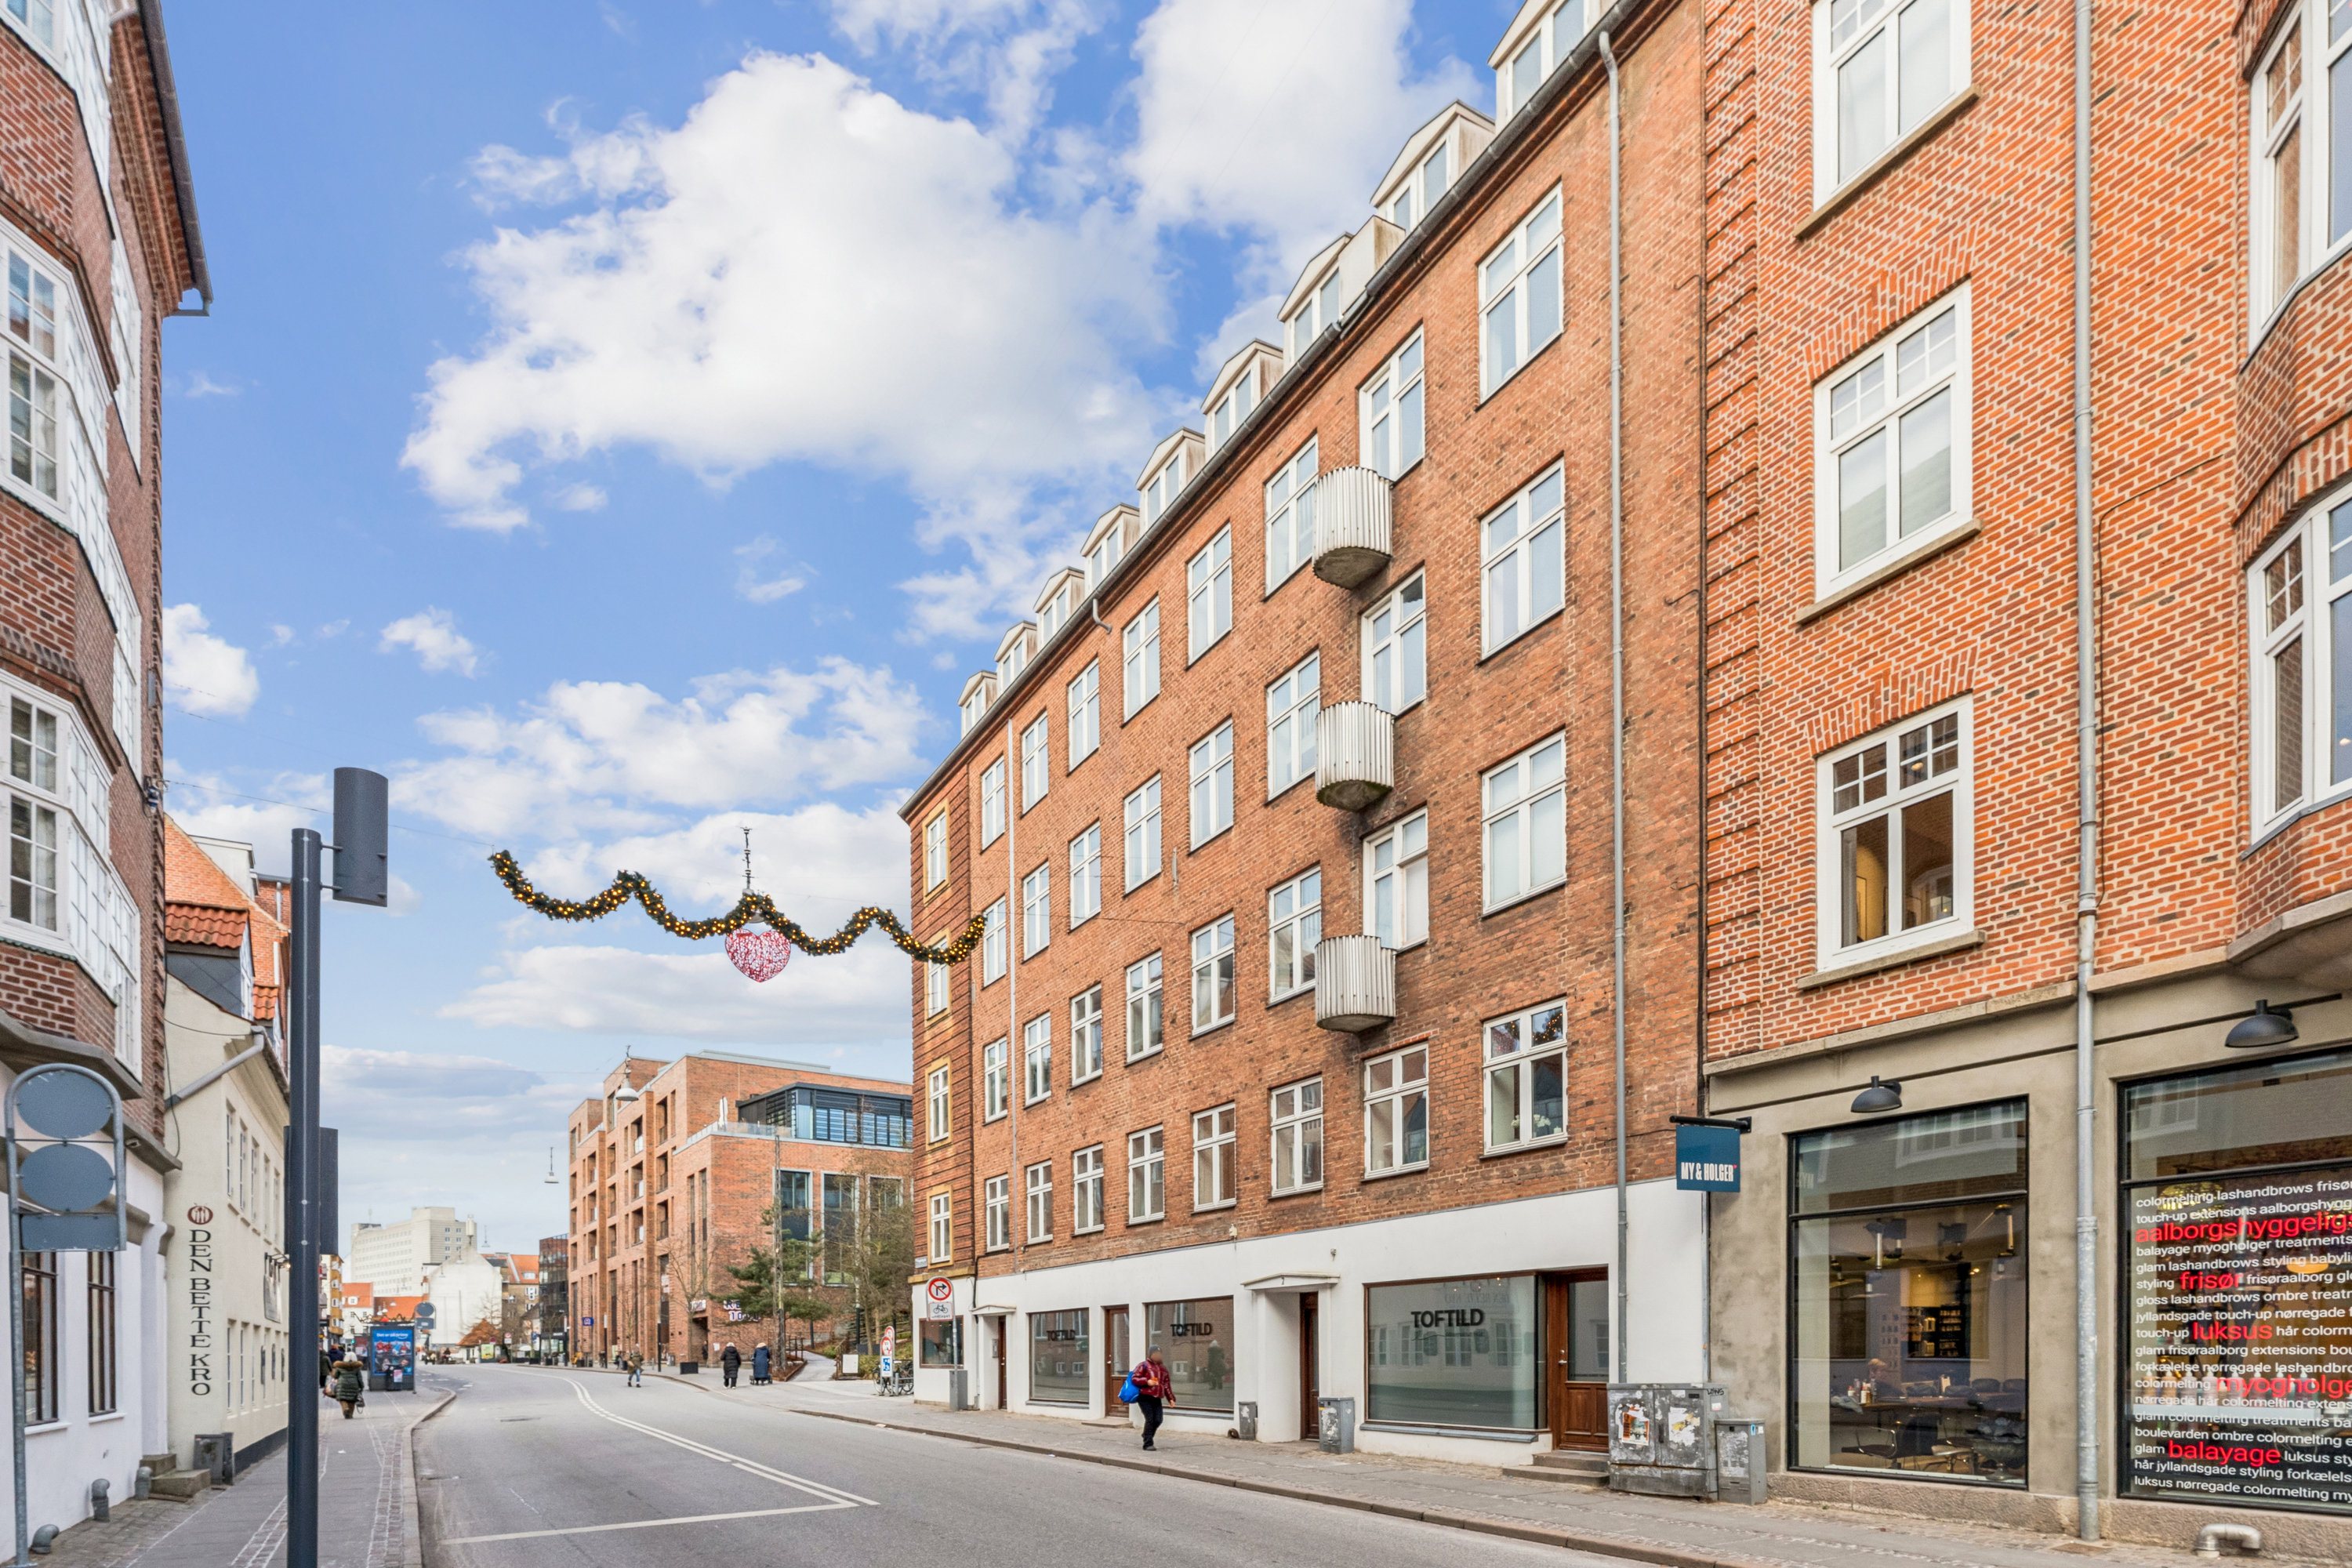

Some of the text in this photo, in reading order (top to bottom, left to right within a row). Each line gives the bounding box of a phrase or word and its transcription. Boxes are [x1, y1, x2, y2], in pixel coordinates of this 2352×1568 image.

[1681, 1162, 1734, 1182] MY & HOLGER
[2136, 1192, 2214, 1207] colormelting
[2217, 1183, 2313, 1200] lashandbrows
[2136, 1210, 2187, 1224] touch-up
[2190, 1206, 2256, 1219] extensions
[2136, 1236, 2352, 1256] balayage myogholger treatments
[2136, 1252, 2352, 1274] glam lashandbrows styling babyli
[2136, 1279, 2174, 1289] styling
[2180, 1272, 2244, 1290] frisør
[2247, 1272, 2333, 1286] frisøraalborg
[2136, 1295, 2168, 1307] gloss
[2171, 1292, 2259, 1305] lashandbrows
[2263, 1290, 2308, 1301] ombre
[190, 1229, 213, 1396] DEN BETTE KRO
[1410, 1308, 1485, 1328] TOFTILD
[2136, 1311, 2212, 1323] jyllandsgade
[2216, 1309, 2272, 1320] touch-up
[2275, 1308, 2346, 1320] nørregade
[1046, 1329, 1076, 1341] TOFTILD
[1170, 1323, 1214, 1337] TOFTILD
[2136, 1328, 2189, 1339] touch-up
[2194, 1322, 2273, 1341] luksus
[2276, 1325, 2299, 1336] hår
[2136, 1345, 2165, 1357] glam
[2169, 1345, 2249, 1357] frisøraalborg
[2252, 1345, 2326, 1355] extensions
[2136, 1361, 2200, 1372] forkælelse
[2202, 1363, 2271, 1374] nørregade
[2136, 1378, 2211, 1391] colormelting
[2135, 1396, 2195, 1406] nørregade
[2198, 1396, 2219, 1406] hår
[2222, 1397, 2303, 1410] colormelting
[2136, 1412, 2165, 1424] glam
[2169, 1413, 2249, 1426] colormelting
[2253, 1416, 2329, 1427] treatments
[2135, 1428, 2209, 1439] boulevarden
[2212, 1431, 2253, 1442] ombre
[2257, 1432, 2342, 1447] colormelting
[2135, 1444, 2165, 1457] glam
[2169, 1439, 2281, 1468] balayage
[2285, 1450, 2330, 1463] luksus
[2135, 1459, 2154, 1469] hår
[2155, 1460, 2236, 1475] jyllandsgade
[2239, 1466, 2283, 1481] styling
[2135, 1475, 2172, 1488] luksus
[2176, 1480, 2241, 1493] nørregade
[2244, 1485, 2328, 1501] colormelting
